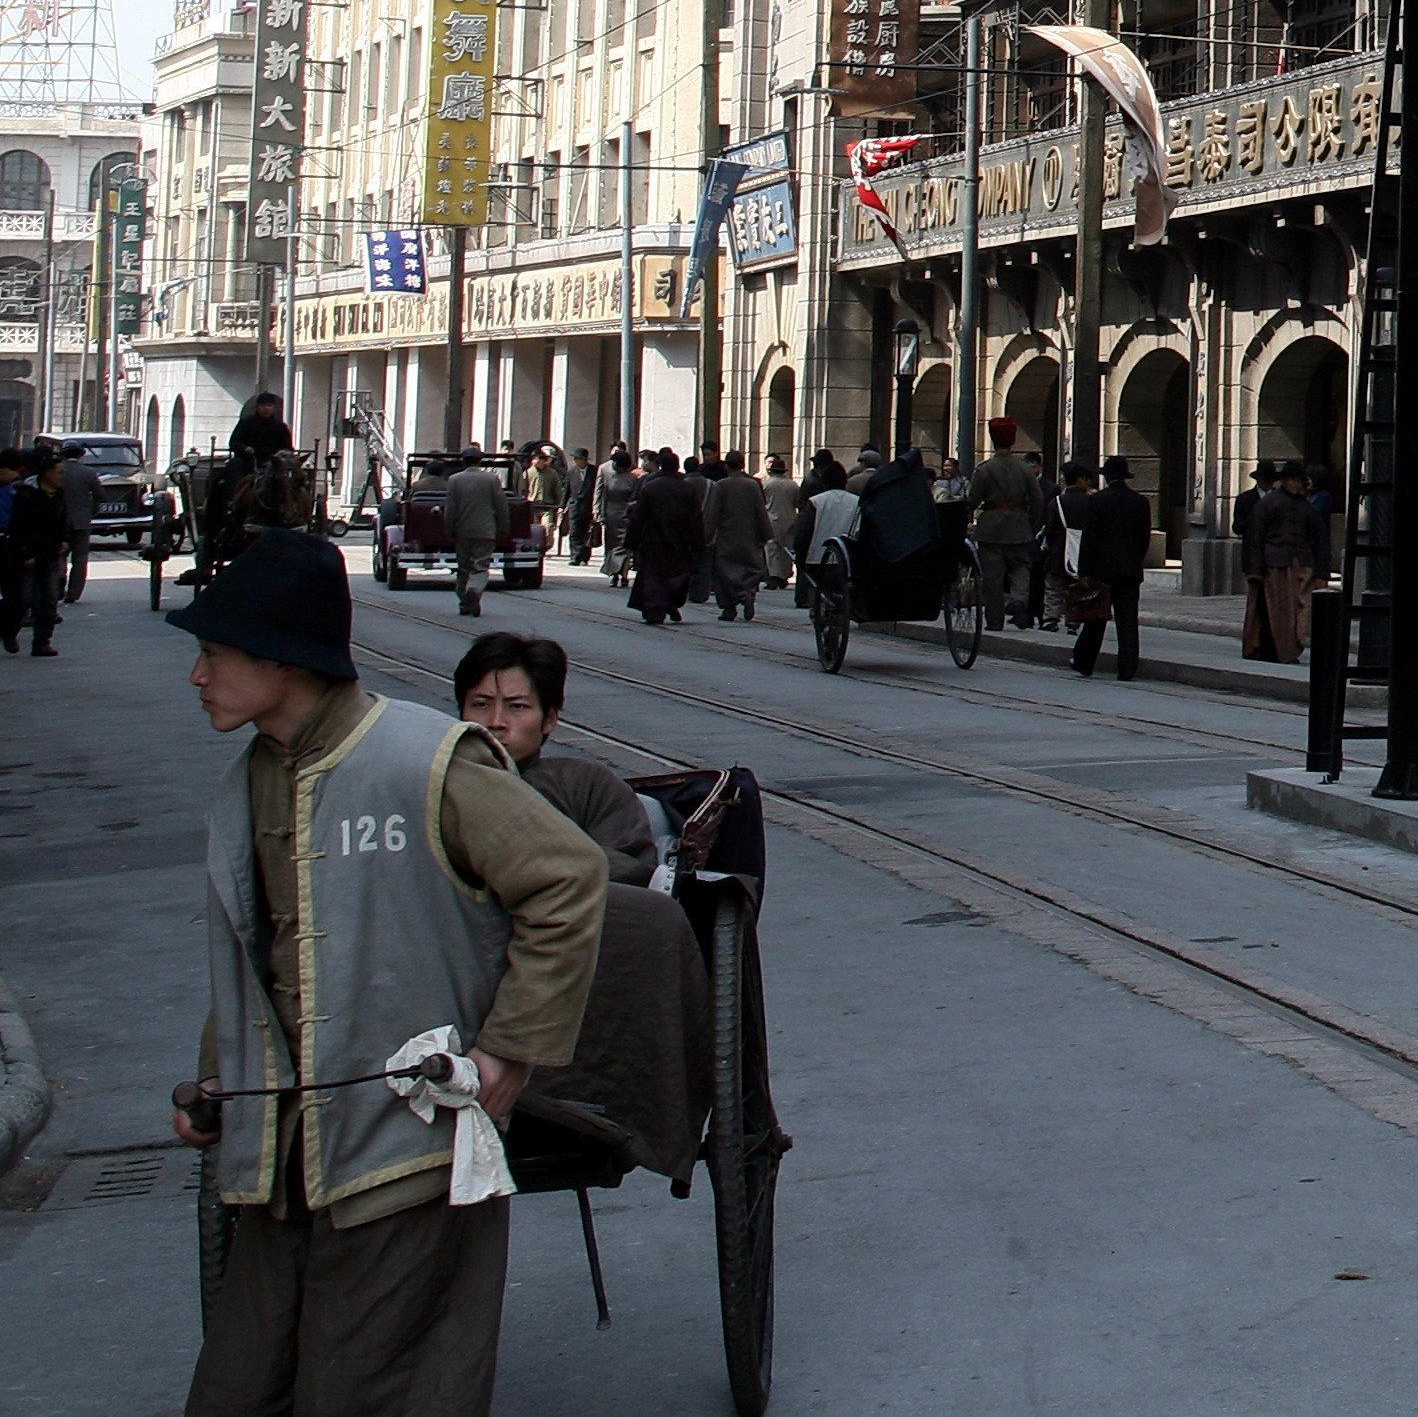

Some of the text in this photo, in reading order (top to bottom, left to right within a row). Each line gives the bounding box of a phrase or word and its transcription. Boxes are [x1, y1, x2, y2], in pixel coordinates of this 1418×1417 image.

[853, 198, 876, 244] THE
[978, 157, 1036, 219] OMPANY
[340, 813, 408, 857] 126
